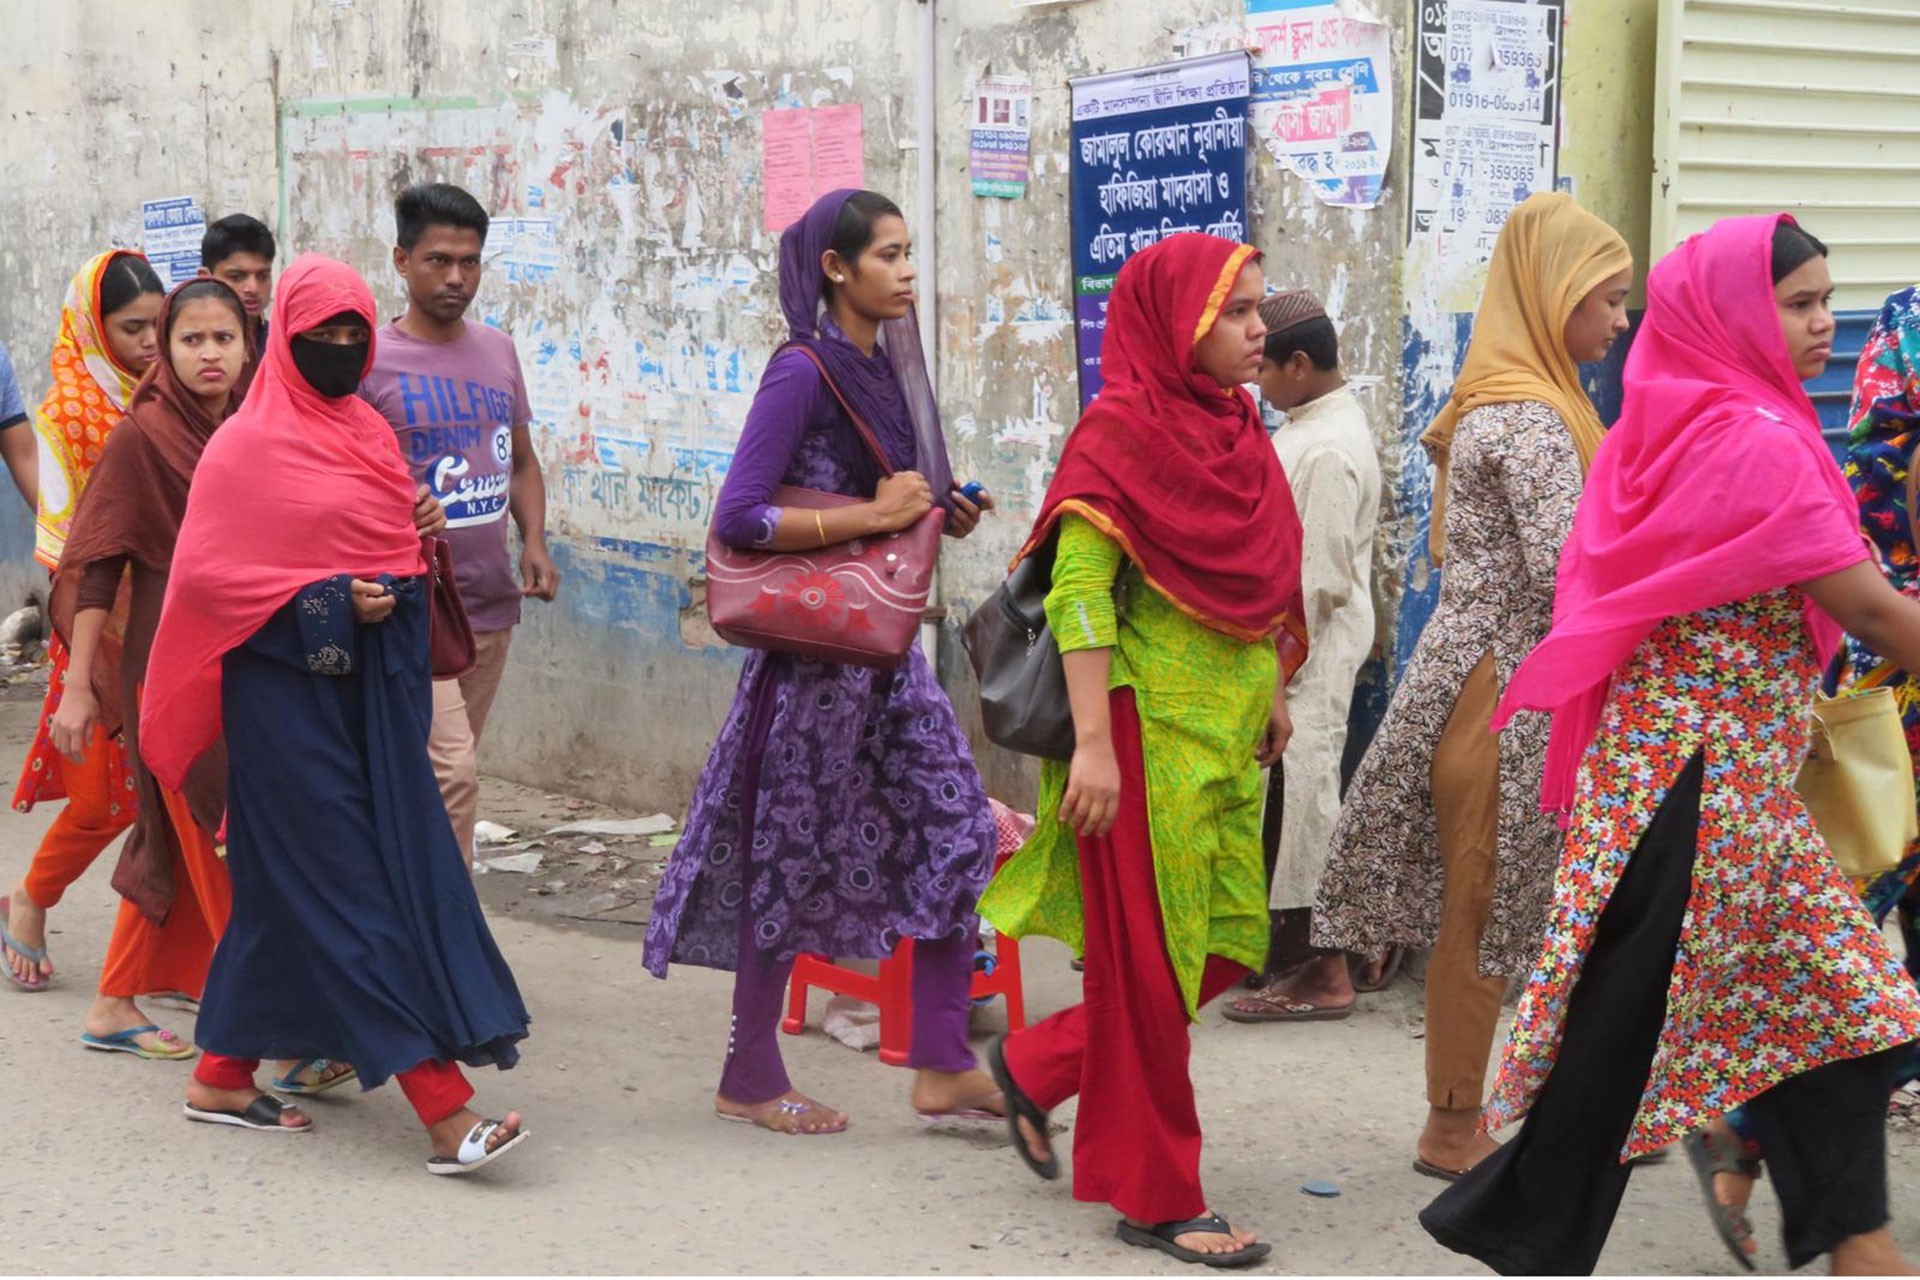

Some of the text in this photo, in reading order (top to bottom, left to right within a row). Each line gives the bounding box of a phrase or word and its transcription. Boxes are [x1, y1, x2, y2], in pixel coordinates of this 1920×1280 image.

[1205, 76, 1248, 97] প্রতিষ্ঠান
[1079, 131, 1130, 171] জামালুল
[1134, 121, 1190, 160] কোরআন
[1097, 170, 1158, 217] হাফিজিয়া
[1216, 172, 1230, 199] ও
[1089, 223, 1127, 263] এতিম
[397, 371, 513, 426] HILFIGE
[410, 423, 481, 462] DENIM
